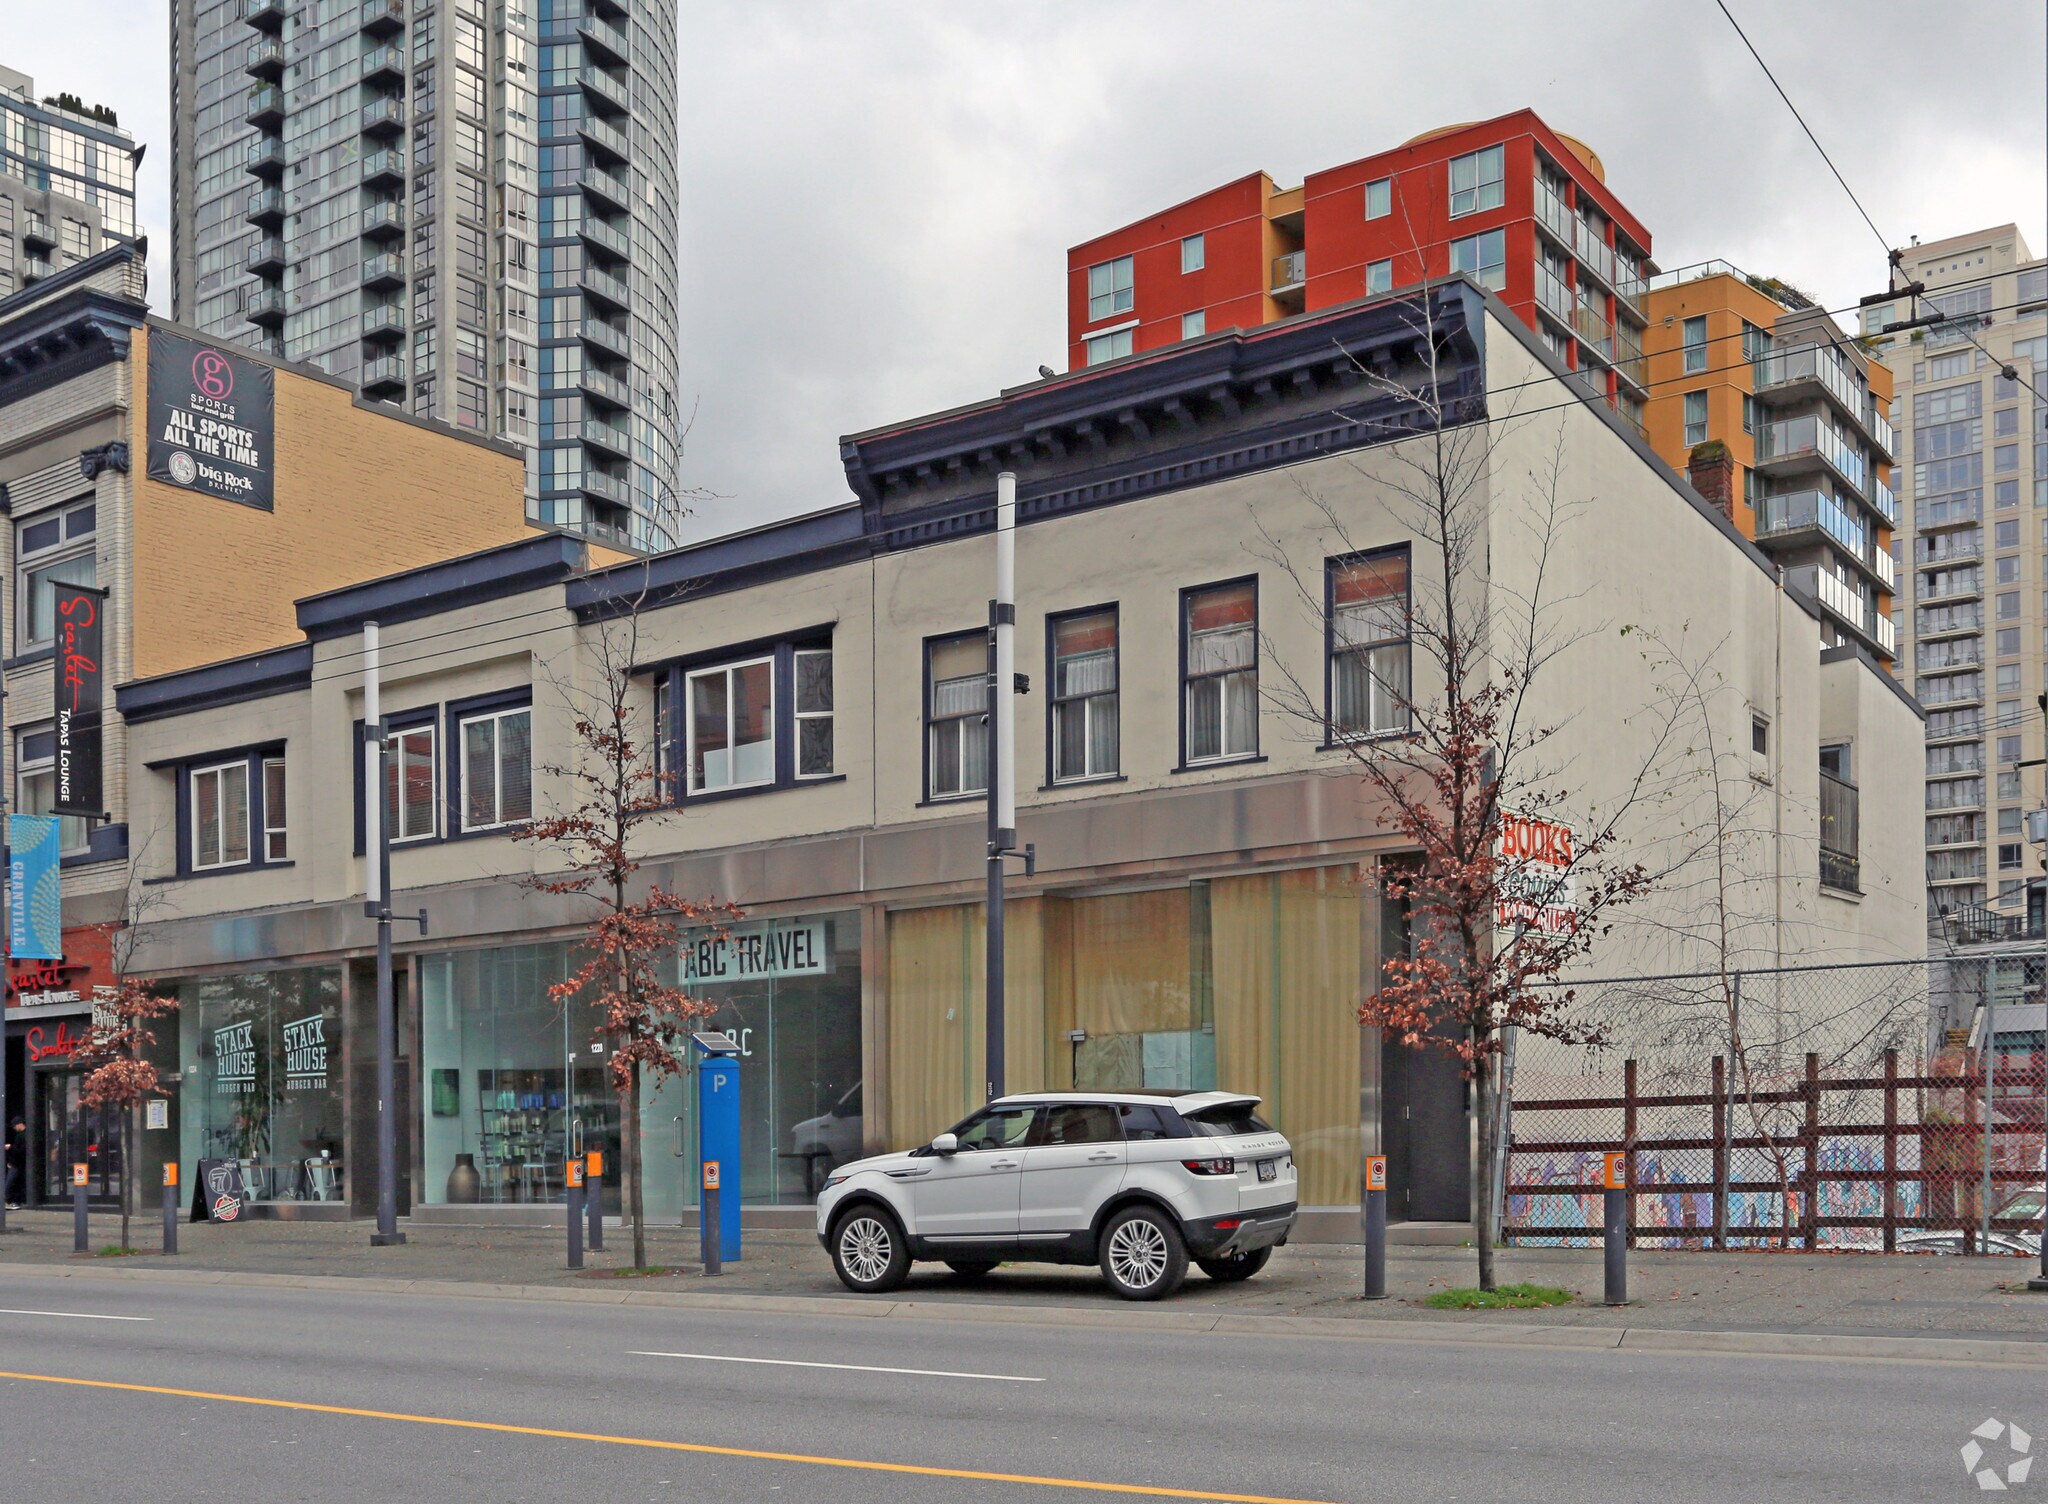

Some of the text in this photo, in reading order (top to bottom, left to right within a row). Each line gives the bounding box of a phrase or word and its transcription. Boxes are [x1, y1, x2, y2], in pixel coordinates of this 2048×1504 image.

[190, 393, 235, 414] SPORTS
[191, 402, 235, 421] bar and grill
[169, 409, 253, 448] ALL SPORTS
[163, 424, 258, 467] ALL THE TIME
[60, 595, 97, 713] Scarlet
[60, 708, 71, 802] TAPAS LOUNGE
[1501, 812, 1573, 867] BOOKS
[12, 861, 26, 946] GRANVILLE
[684, 928, 819, 979] ABC TRAVEL
[214, 1025, 254, 1057] STACK
[283, 1019, 325, 1053] STACK
[217, 1051, 255, 1076] HOUSE
[286, 1046, 327, 1072] HOUSE
[217, 1082, 256, 1094] BURGER BAR
[286, 1078, 327, 1090] BURGER BAR
[713, 1074, 727, 1093] P
